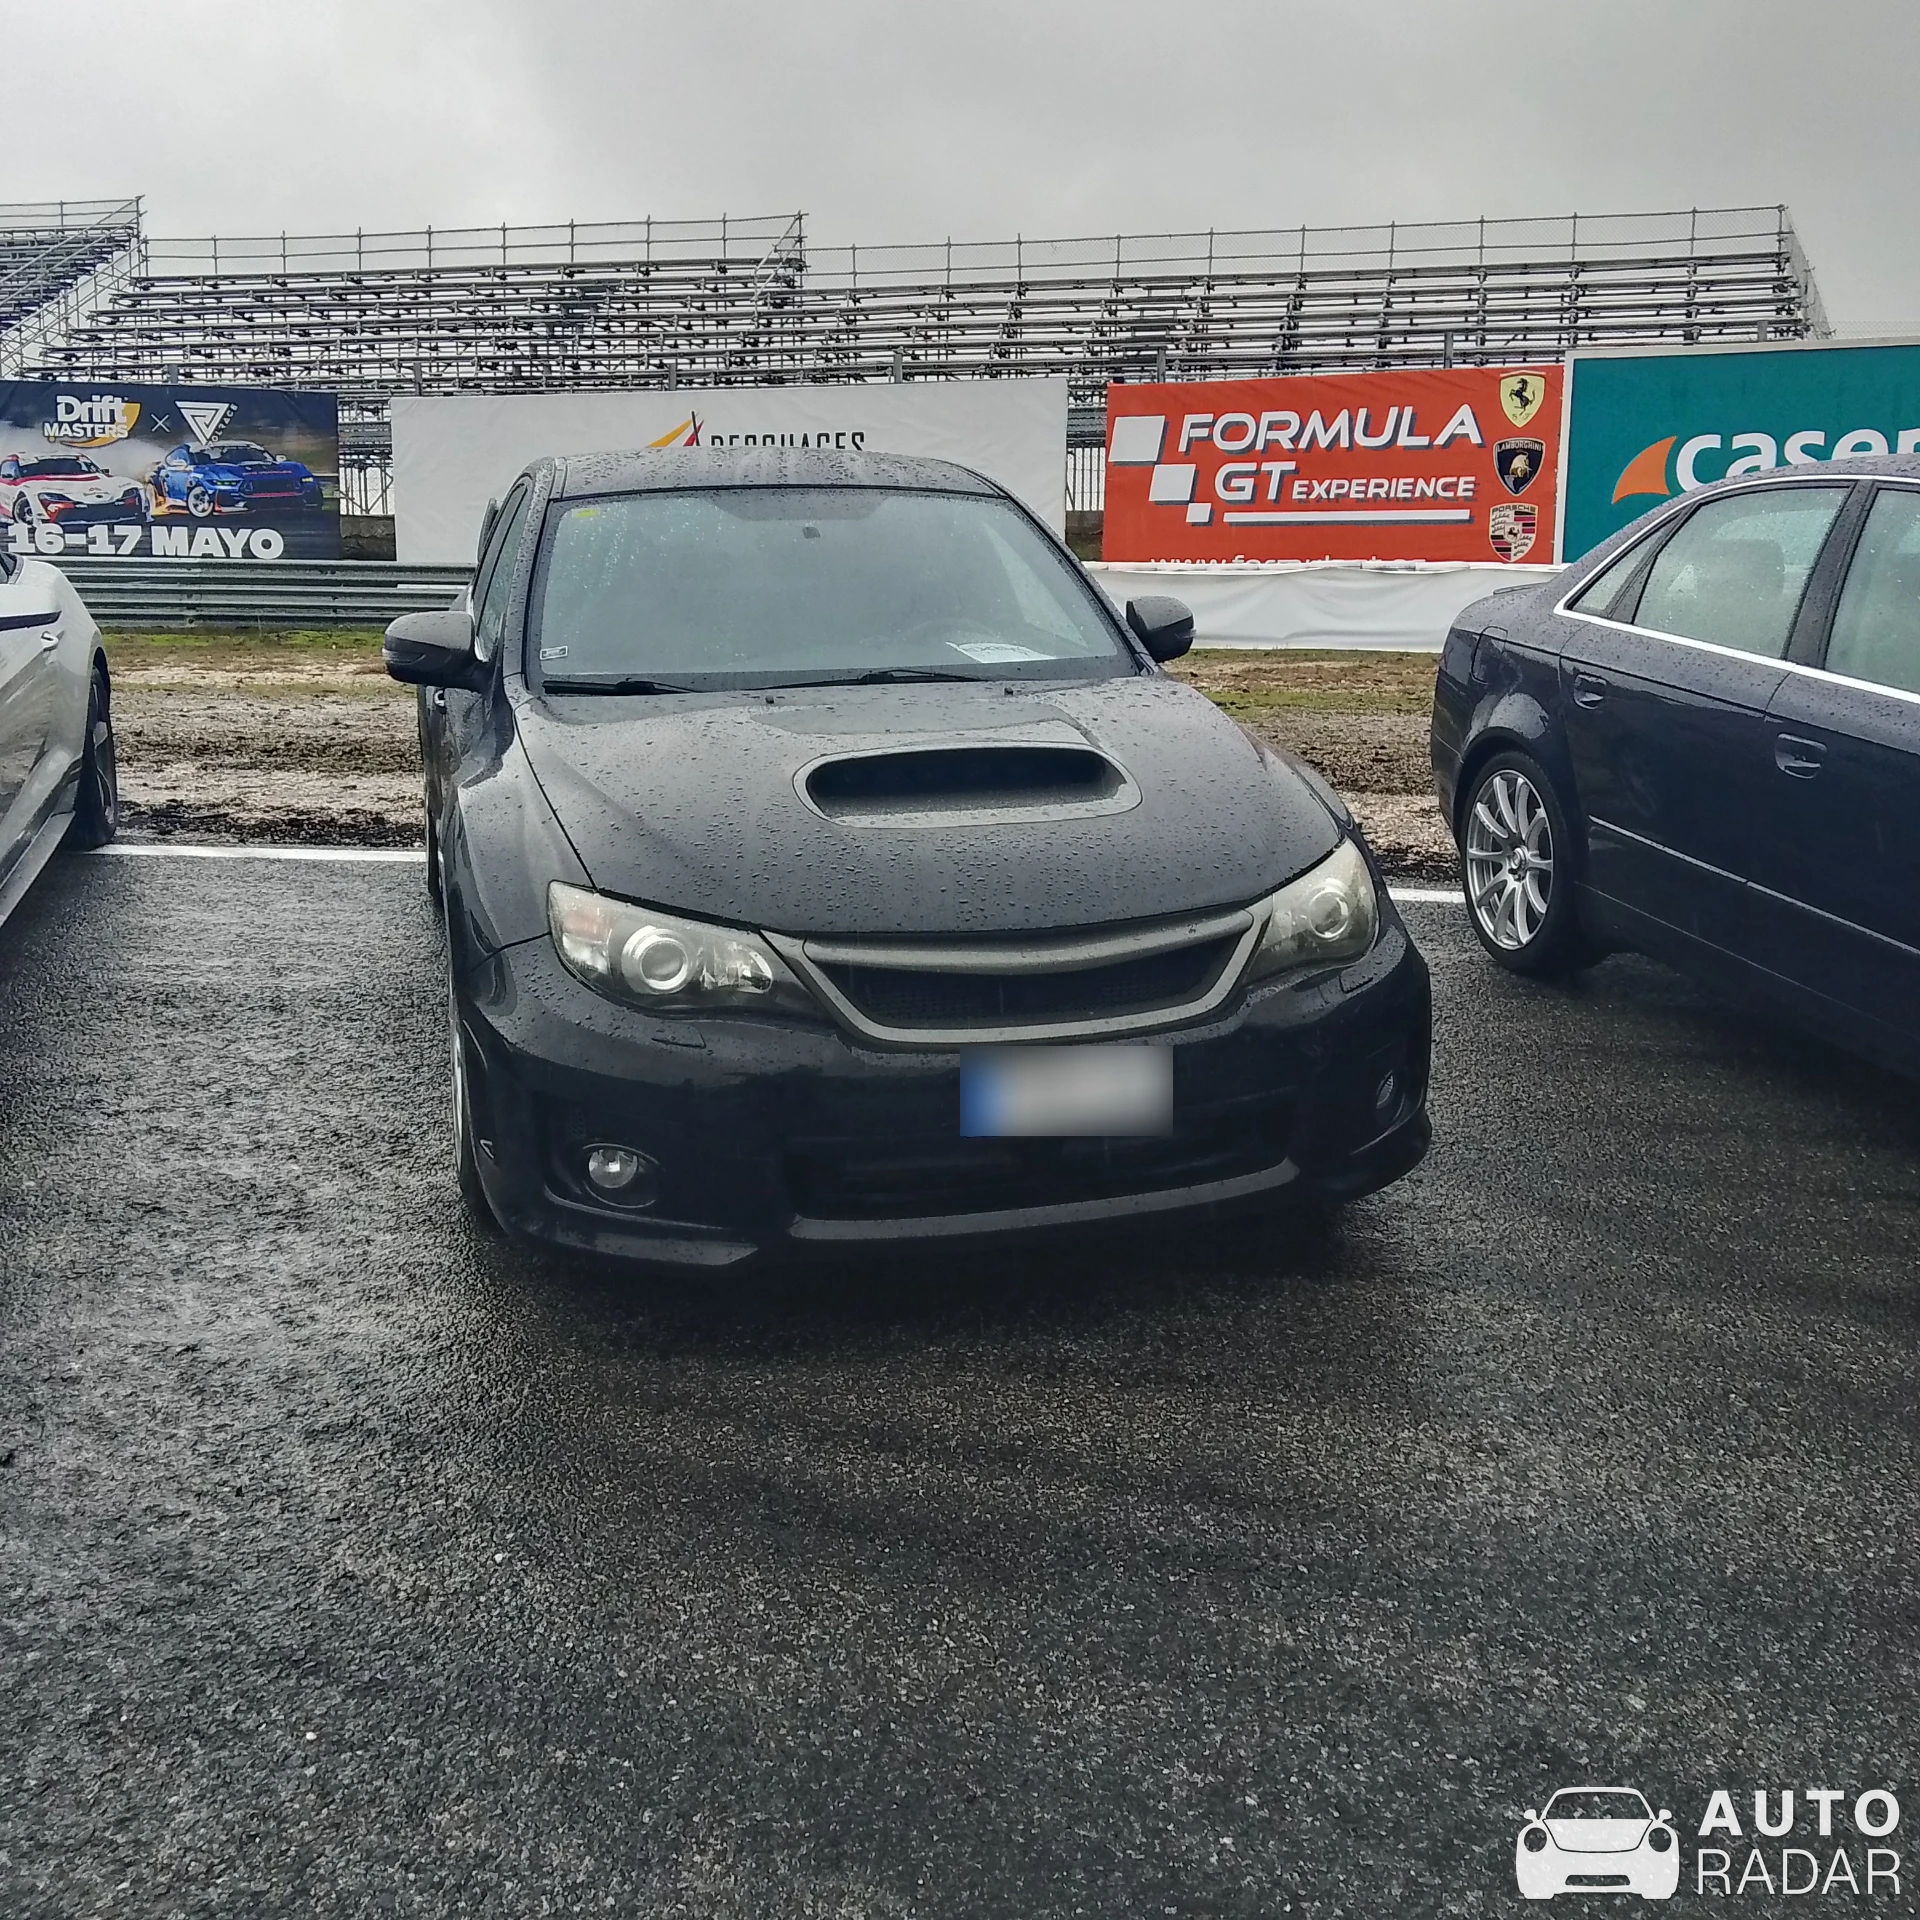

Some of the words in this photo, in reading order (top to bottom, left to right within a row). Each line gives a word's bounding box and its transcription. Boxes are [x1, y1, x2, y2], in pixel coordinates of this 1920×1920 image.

[57, 394, 126, 423] Drift
[44, 422, 129, 439] MASTERS
[1178, 403, 1483, 453] FORMULA
[1496, 440, 1542, 452] LAMBORGHINI
[1214, 461, 1297, 501] GT
[1292, 476, 1477, 500] EXPERIENCE
[1491, 504, 1536, 515] PORSCHE
[8, 523, 142, 555] 16-17
[151, 525, 285, 560] MAYO
